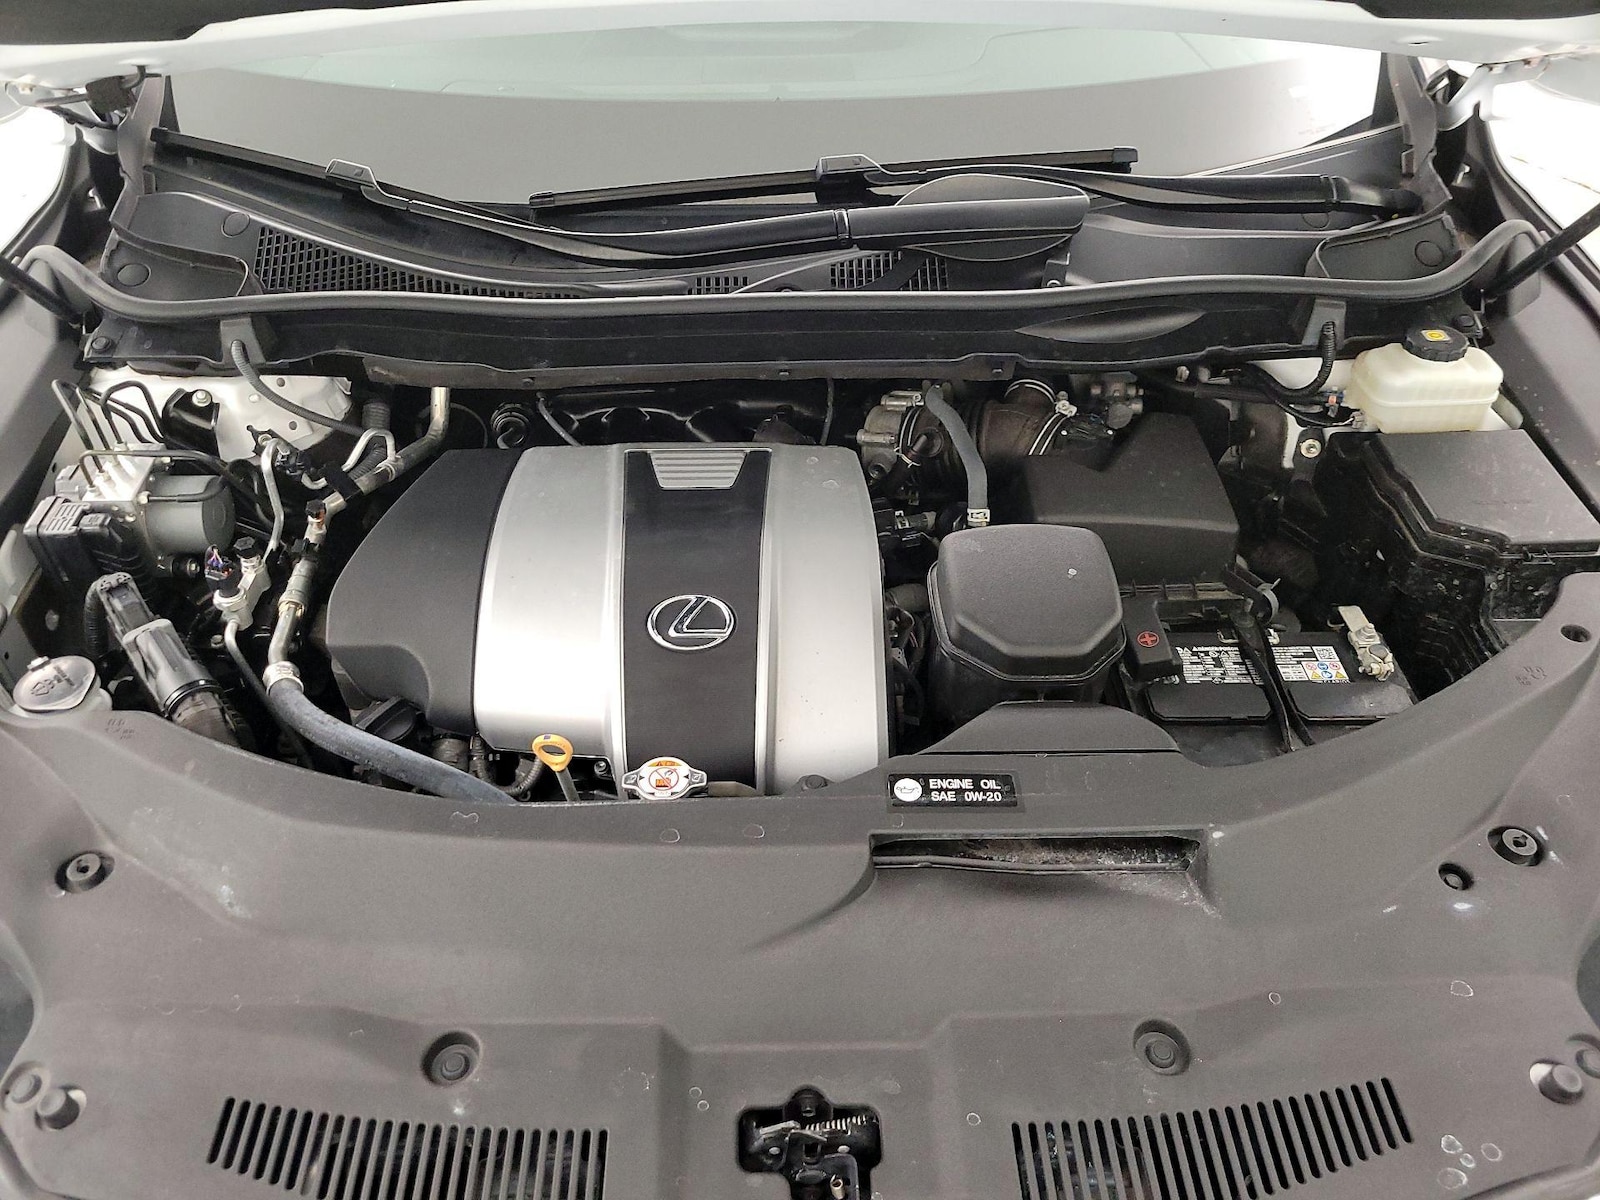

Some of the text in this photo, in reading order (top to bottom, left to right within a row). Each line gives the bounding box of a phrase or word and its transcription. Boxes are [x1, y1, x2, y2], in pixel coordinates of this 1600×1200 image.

[929, 779, 1001, 790] ENGINE OIL
[931, 791, 1002, 802] SAE 0W-20
